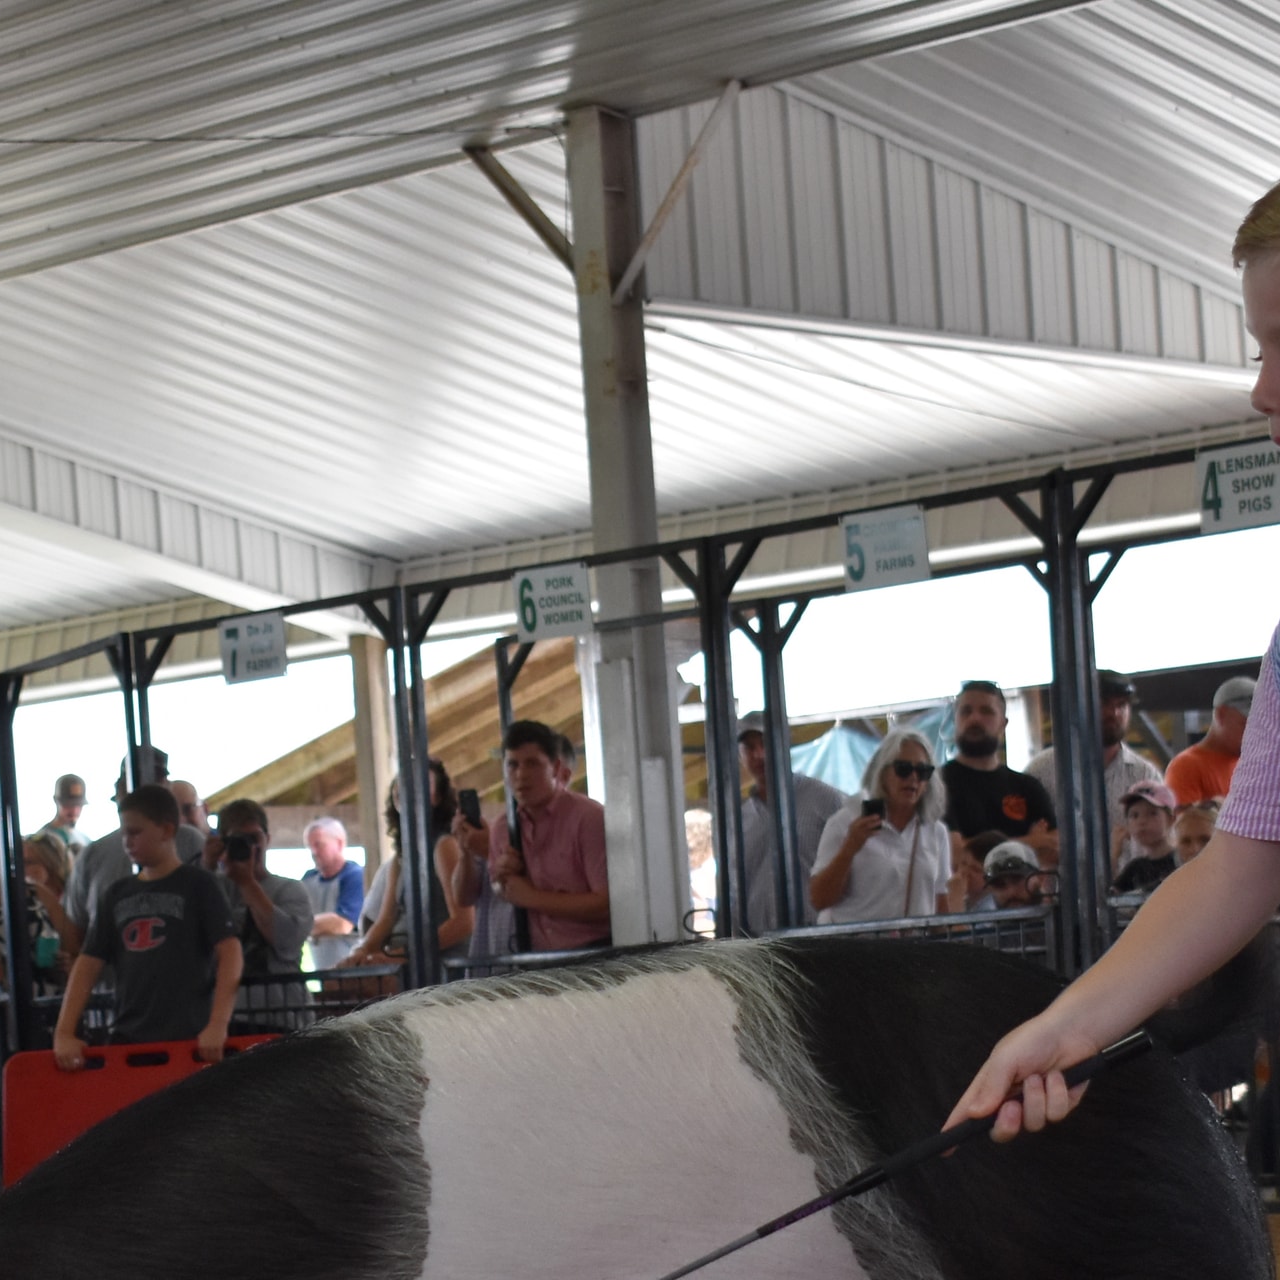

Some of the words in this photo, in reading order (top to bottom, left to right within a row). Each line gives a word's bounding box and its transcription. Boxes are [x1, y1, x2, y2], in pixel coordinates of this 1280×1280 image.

[1202, 460, 1222, 521] 4
[1231, 472, 1275, 494] SHOW
[1238, 495, 1272, 515] PIGS
[845, 523, 866, 584] 5
[874, 554, 915, 573] FARMS
[543, 575, 573, 591] PORK
[518, 576, 538, 635] 6
[538, 592, 585, 609] COUNCIL
[543, 610, 583, 625] WOMEN
[224, 626, 239, 679] 7
